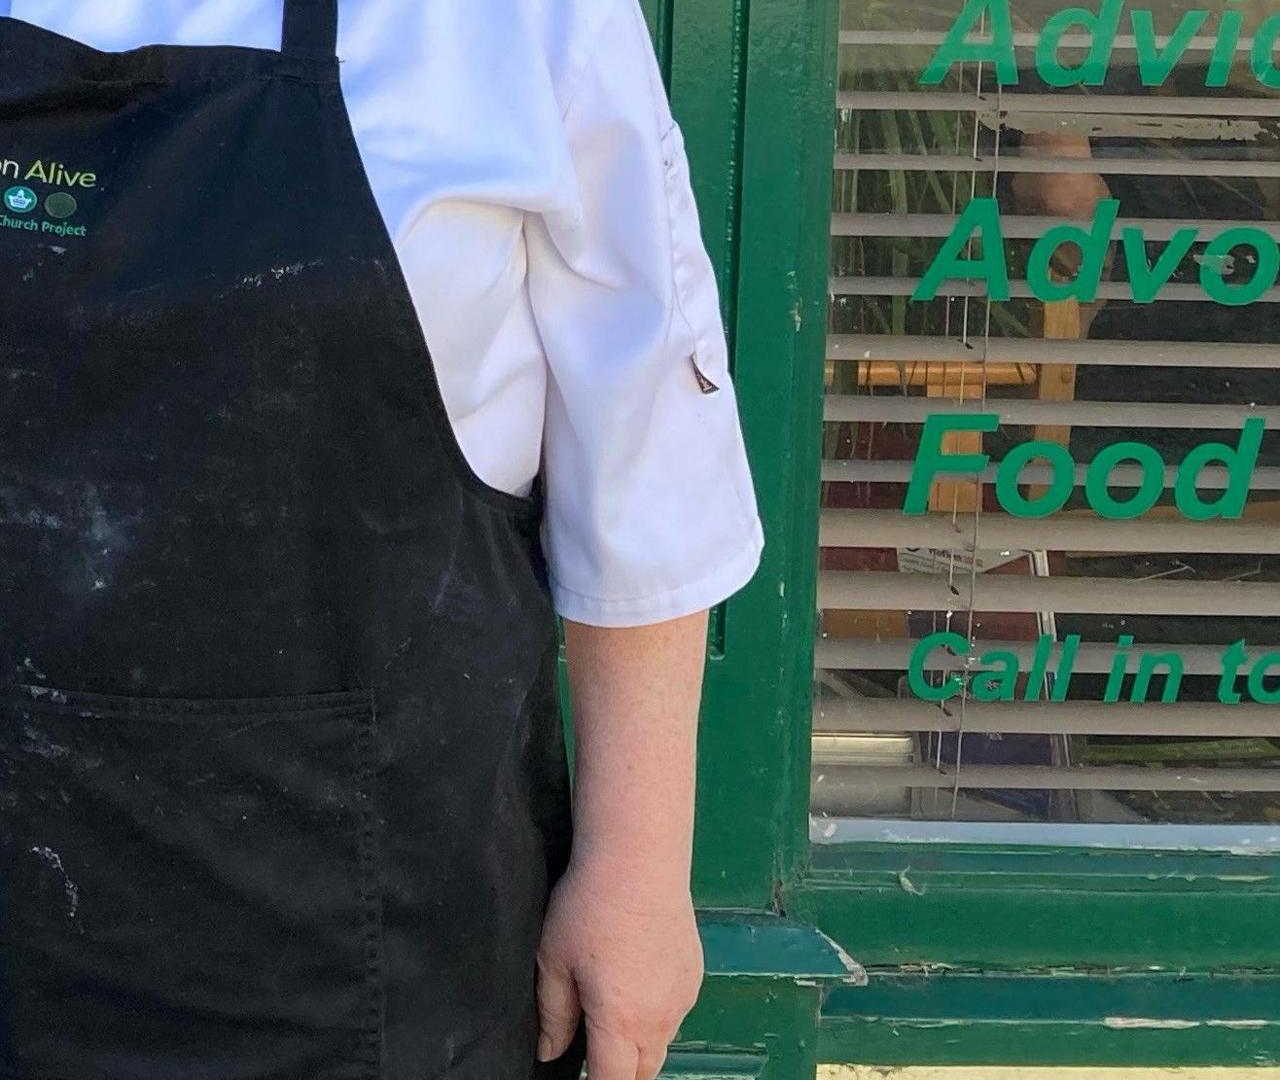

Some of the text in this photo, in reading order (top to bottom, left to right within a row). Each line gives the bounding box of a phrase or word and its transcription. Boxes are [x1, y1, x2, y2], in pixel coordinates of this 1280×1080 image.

[24, 159, 97, 188] Alive
[41, 220, 87, 237] Project
[910, 197, 1280, 307] Advo
[902, 414, 1266, 520] Food
[908, 631, 1280, 704] Call in to
